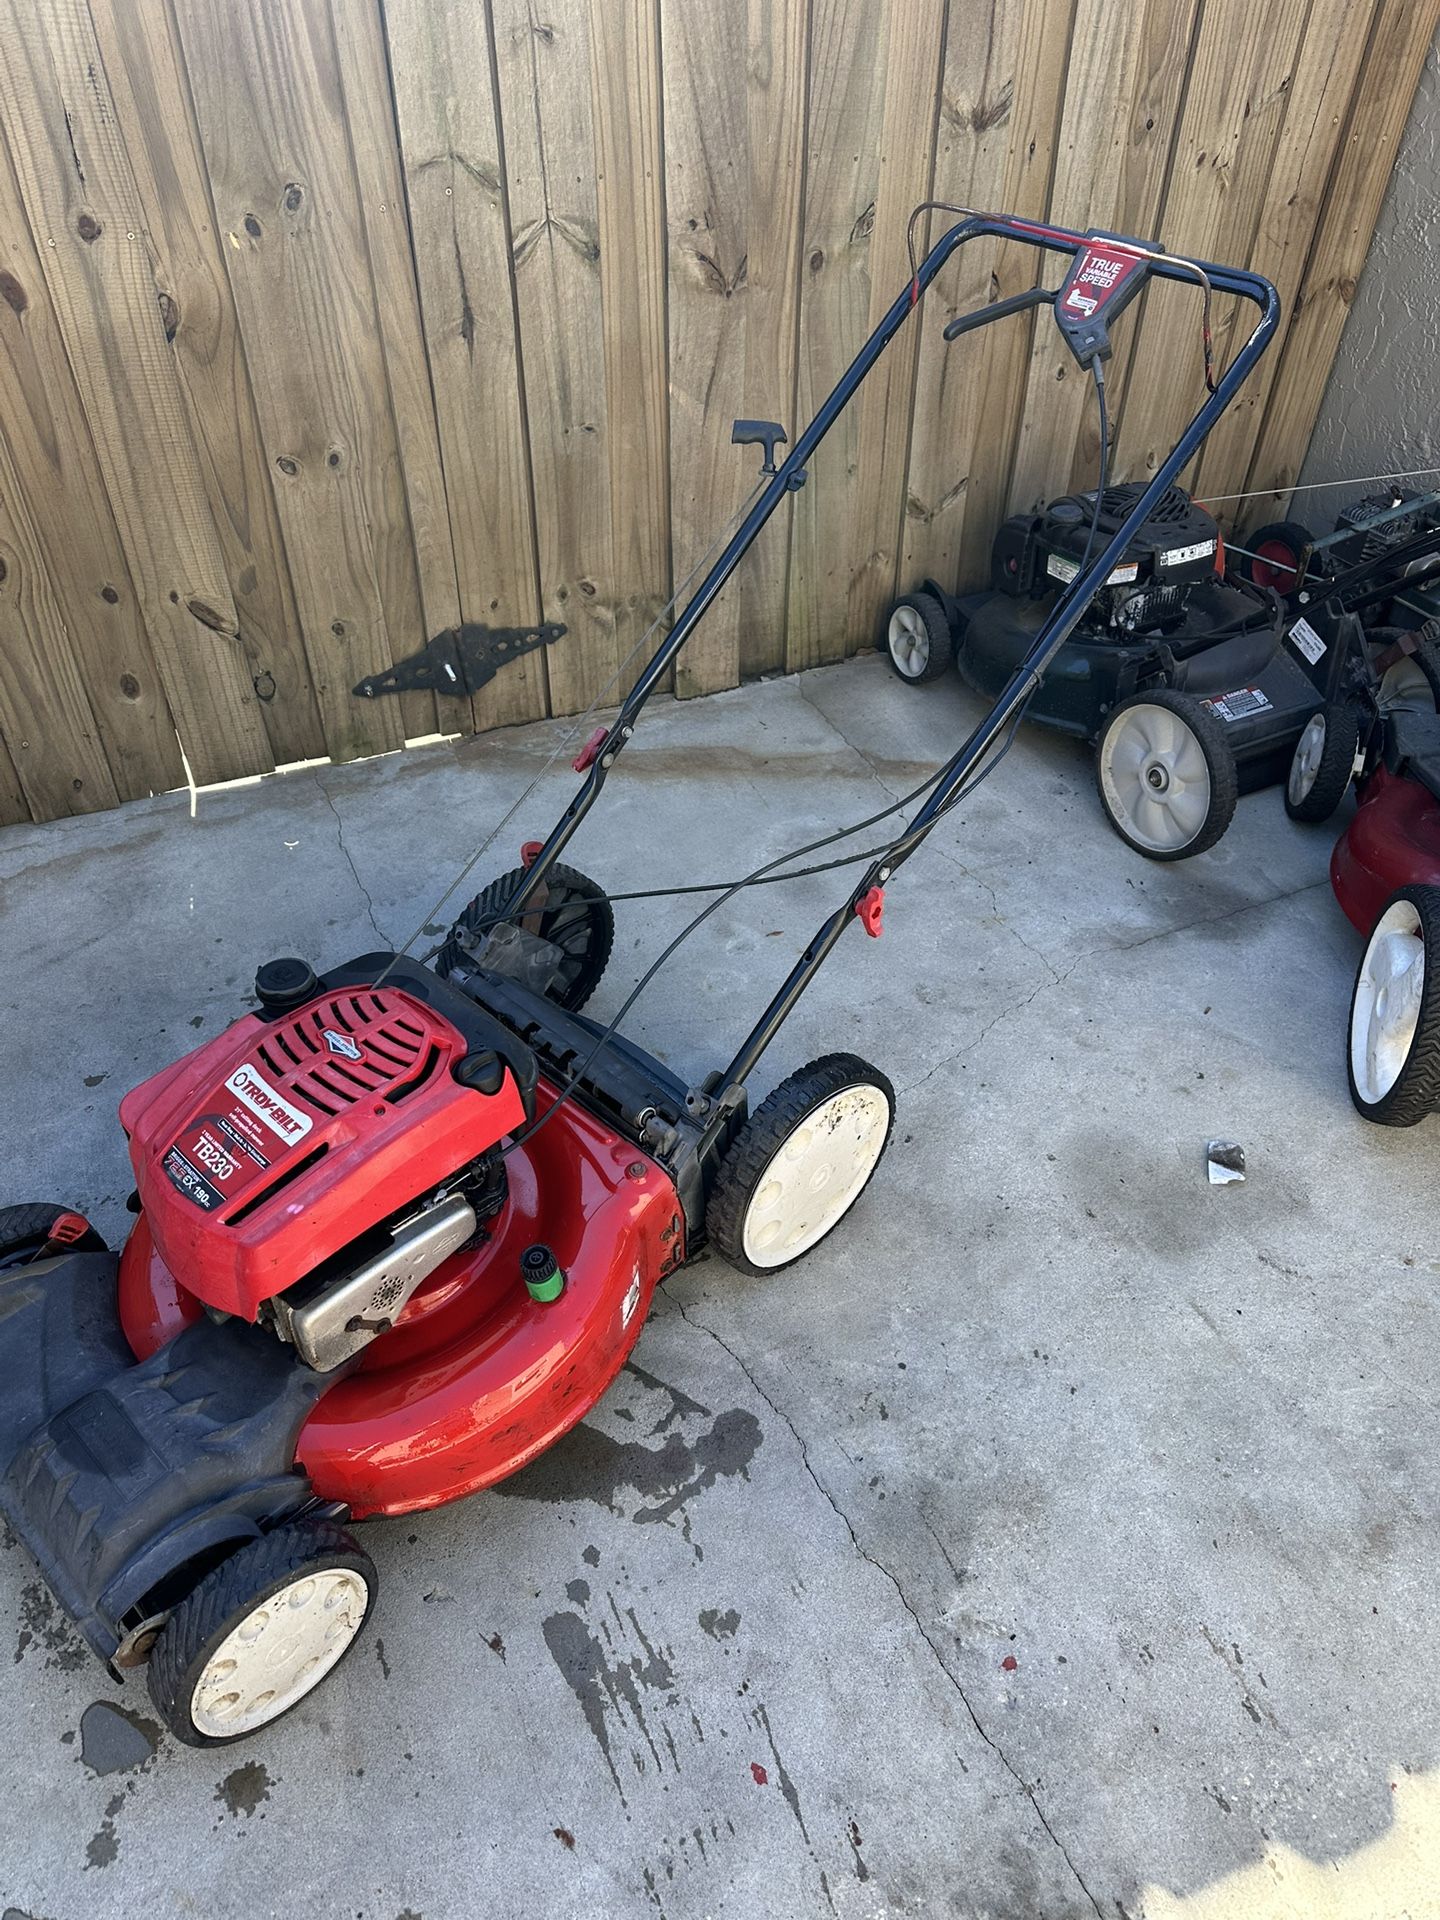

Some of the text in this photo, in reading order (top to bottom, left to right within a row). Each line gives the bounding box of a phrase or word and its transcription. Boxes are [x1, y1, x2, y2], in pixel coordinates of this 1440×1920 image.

[1085, 268, 1118, 280] VARIABLE
[1090, 257, 1124, 274] TRUE
[1080, 274, 1113, 288] SPEED
[240, 1079, 302, 1135] TROY-BILT
[192, 1135, 235, 1182] TB230
